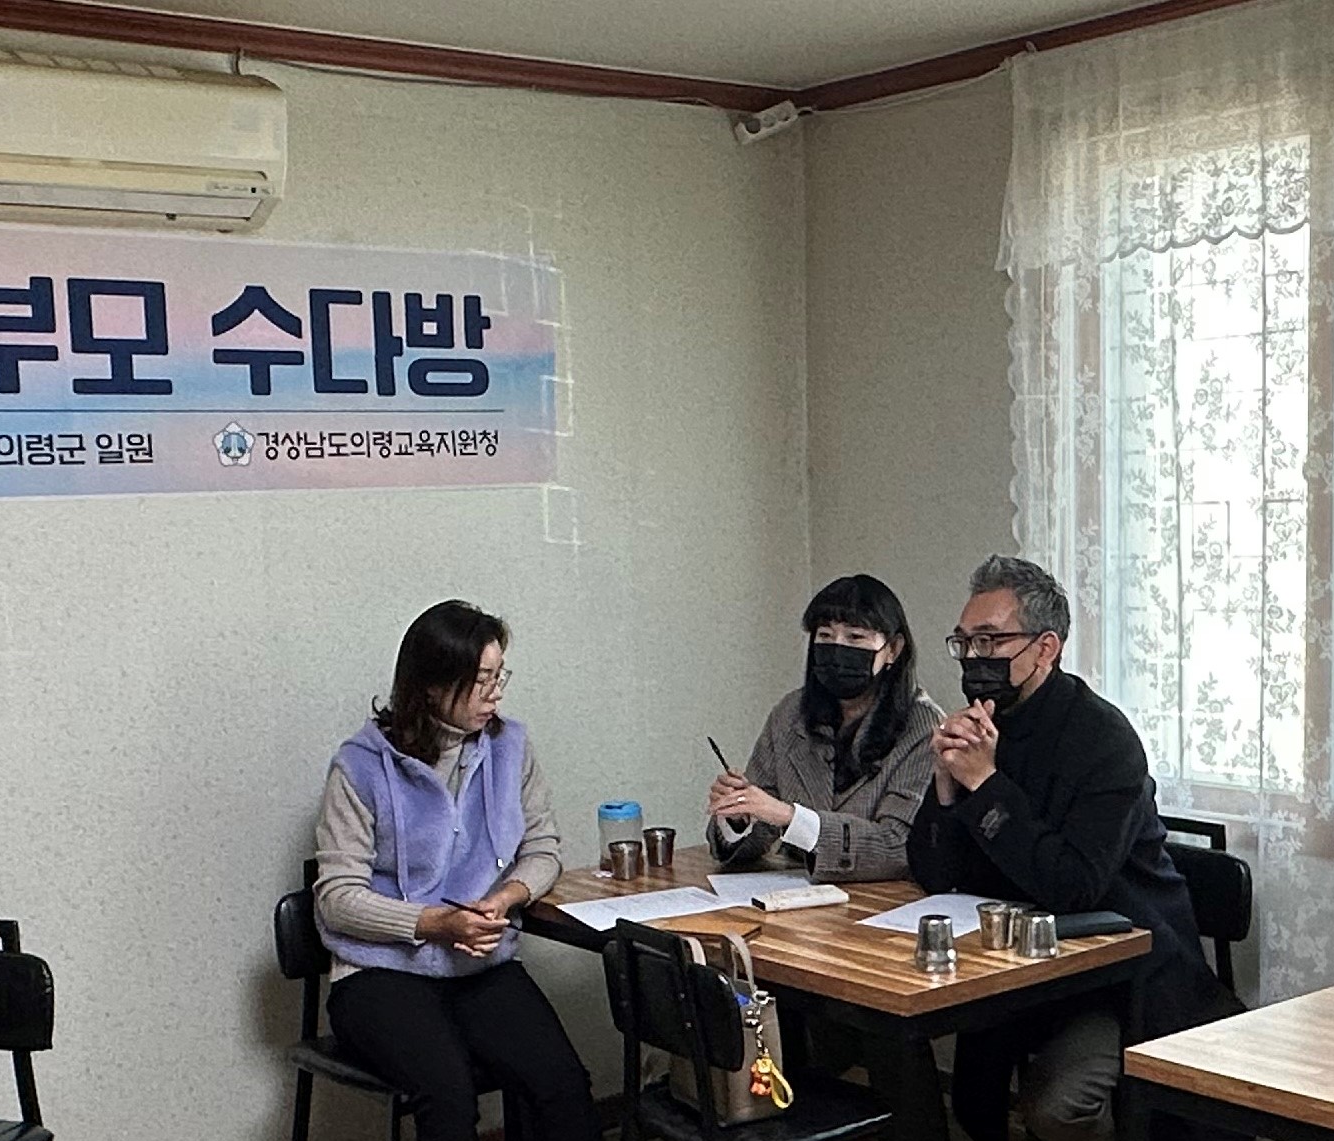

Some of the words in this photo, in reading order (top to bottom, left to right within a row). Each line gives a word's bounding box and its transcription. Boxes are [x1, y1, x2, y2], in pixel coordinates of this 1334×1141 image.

[211, 285, 492, 398] 수다방
[95, 433, 155, 466] 일원
[256, 429, 499, 462] 경상남도의령교육지원청
